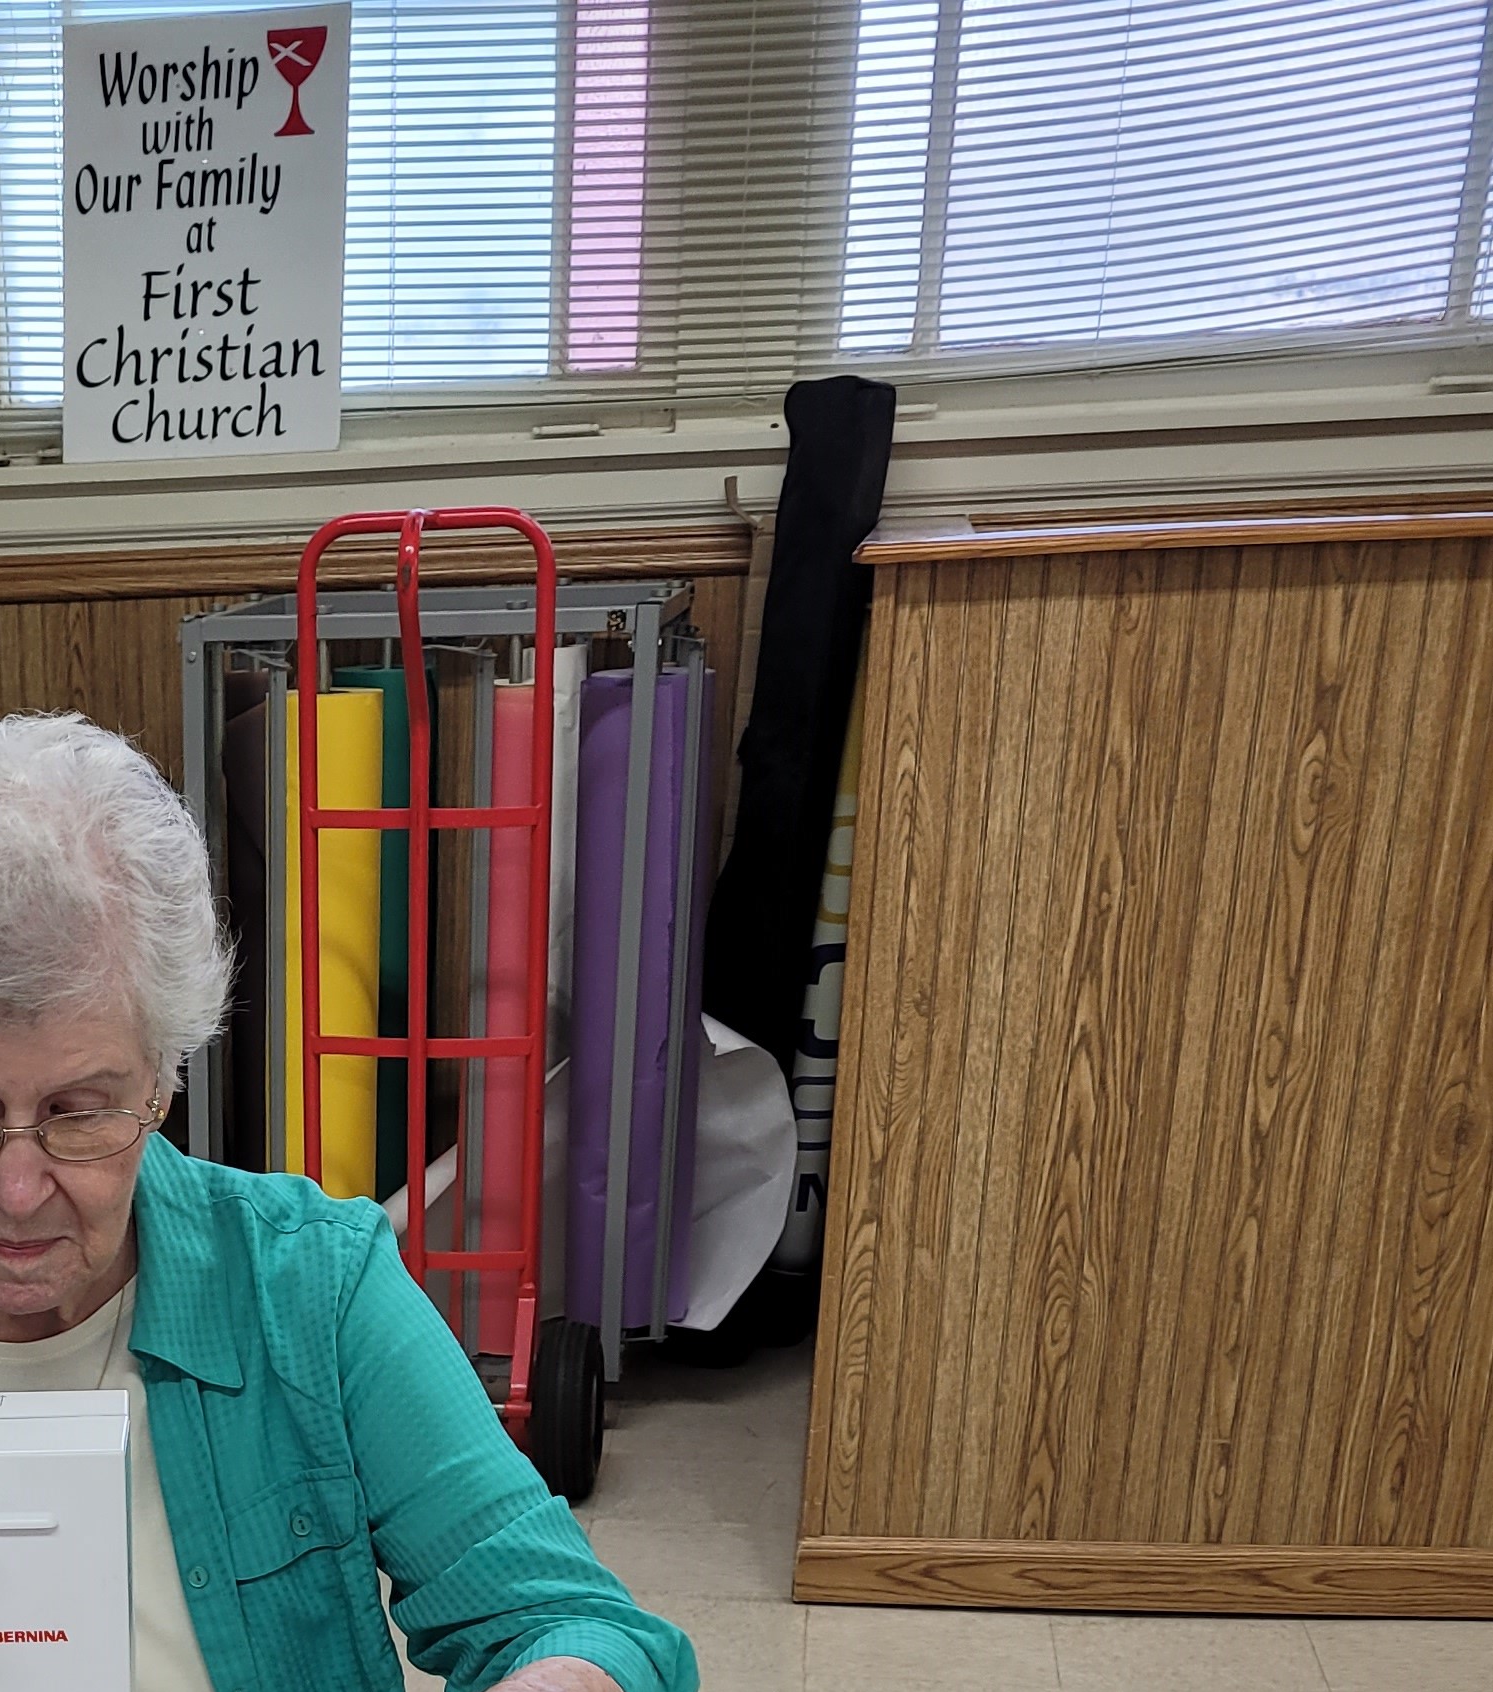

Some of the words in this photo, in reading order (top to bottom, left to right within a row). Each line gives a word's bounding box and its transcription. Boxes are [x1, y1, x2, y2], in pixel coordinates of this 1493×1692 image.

[98, 45, 259, 110] Worship
[141, 106, 214, 155] with
[75, 163, 142, 215] Our
[156, 152, 282, 215] Family
[186, 216, 215, 254] at
[141, 263, 262, 322] First
[75, 323, 326, 389] Christian
[111, 381, 287, 444] Church
